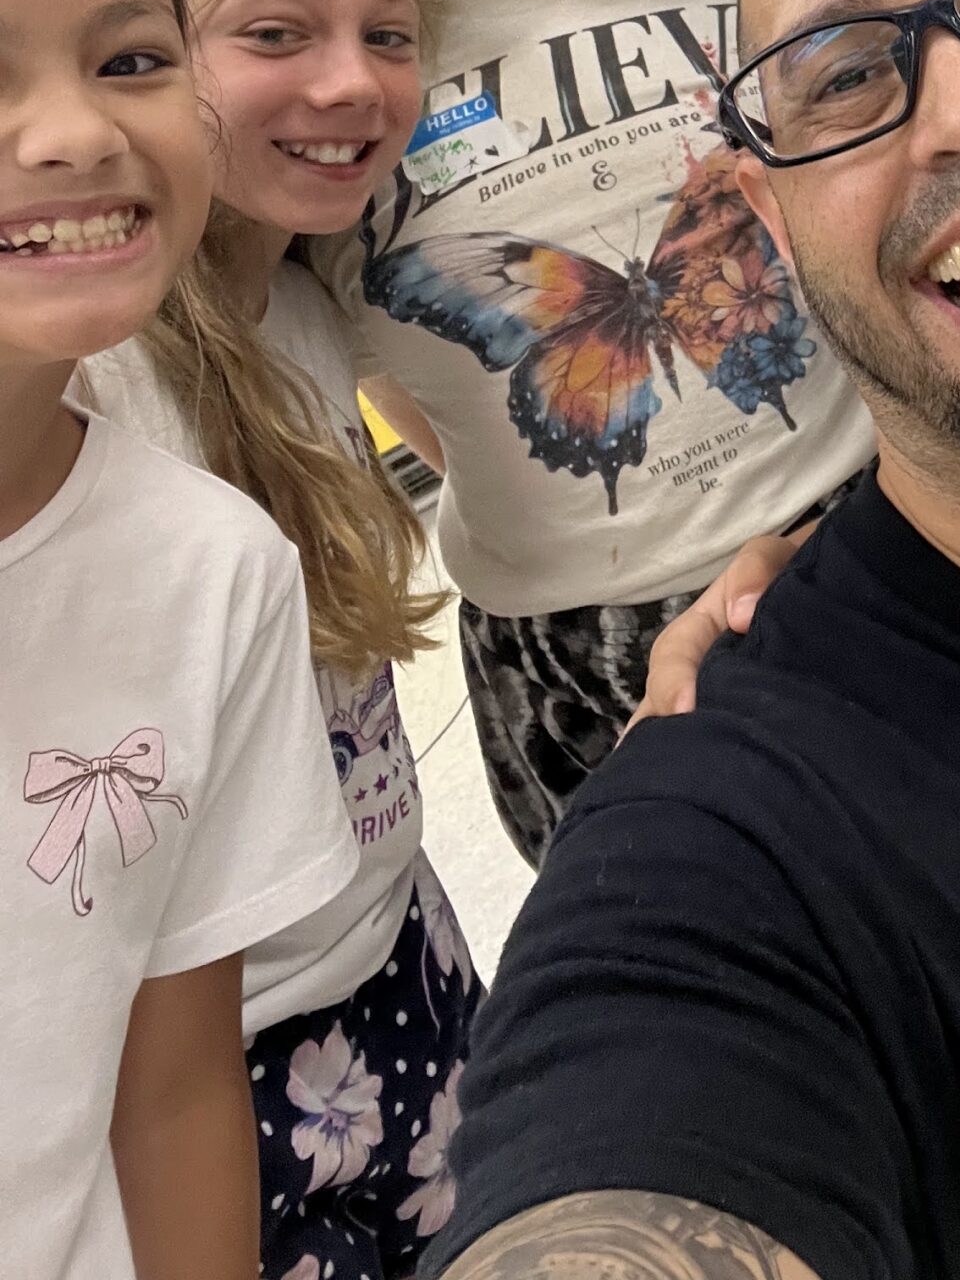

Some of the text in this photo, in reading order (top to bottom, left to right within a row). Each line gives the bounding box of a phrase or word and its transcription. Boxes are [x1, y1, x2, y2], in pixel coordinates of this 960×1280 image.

[425, 97, 488, 132] HELLO
[477, 111, 701, 203] Believe in who you are
[591, 159, 618, 192] &
[647, 422, 750, 477] who you were
[672, 448, 738, 487] meant to
[698, 477, 724, 494] be.
